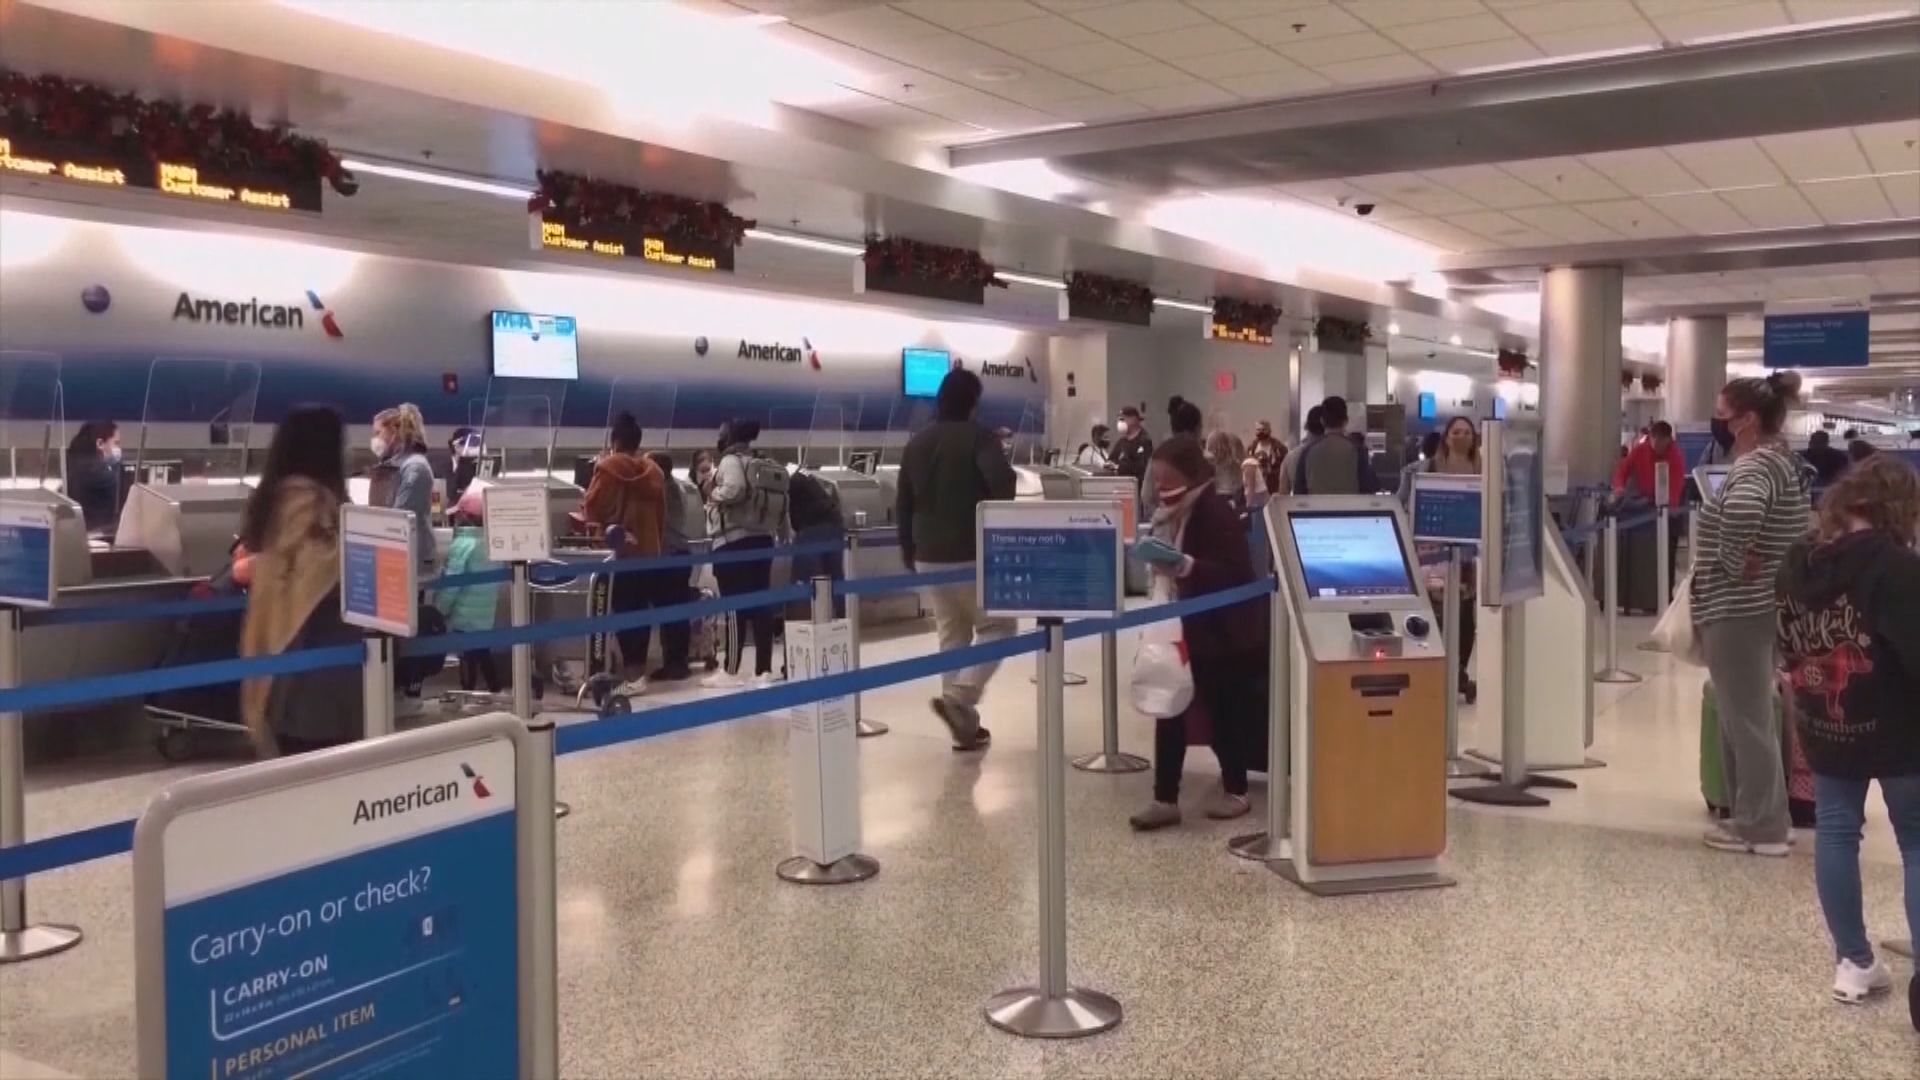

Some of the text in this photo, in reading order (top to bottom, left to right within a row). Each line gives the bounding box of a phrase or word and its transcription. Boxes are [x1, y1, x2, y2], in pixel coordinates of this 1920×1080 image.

[63, 162, 126, 185] Assist
[162, 177, 290, 208] Customer Assist
[542, 232, 625, 256] Customer Assist
[643, 247, 716, 269] Customer Assist
[173, 291, 304, 329] American
[738, 338, 802, 362] American
[981, 360, 1025, 377] American
[991, 534, 1067, 545] These may not fly
[353, 779, 459, 825] American
[190, 865, 432, 965] Carry-on or check?
[223, 953, 329, 1006] CARRY-ON
[225, 1023, 328, 1077] PERSONAL
[333, 1003, 376, 1034] ITEM
